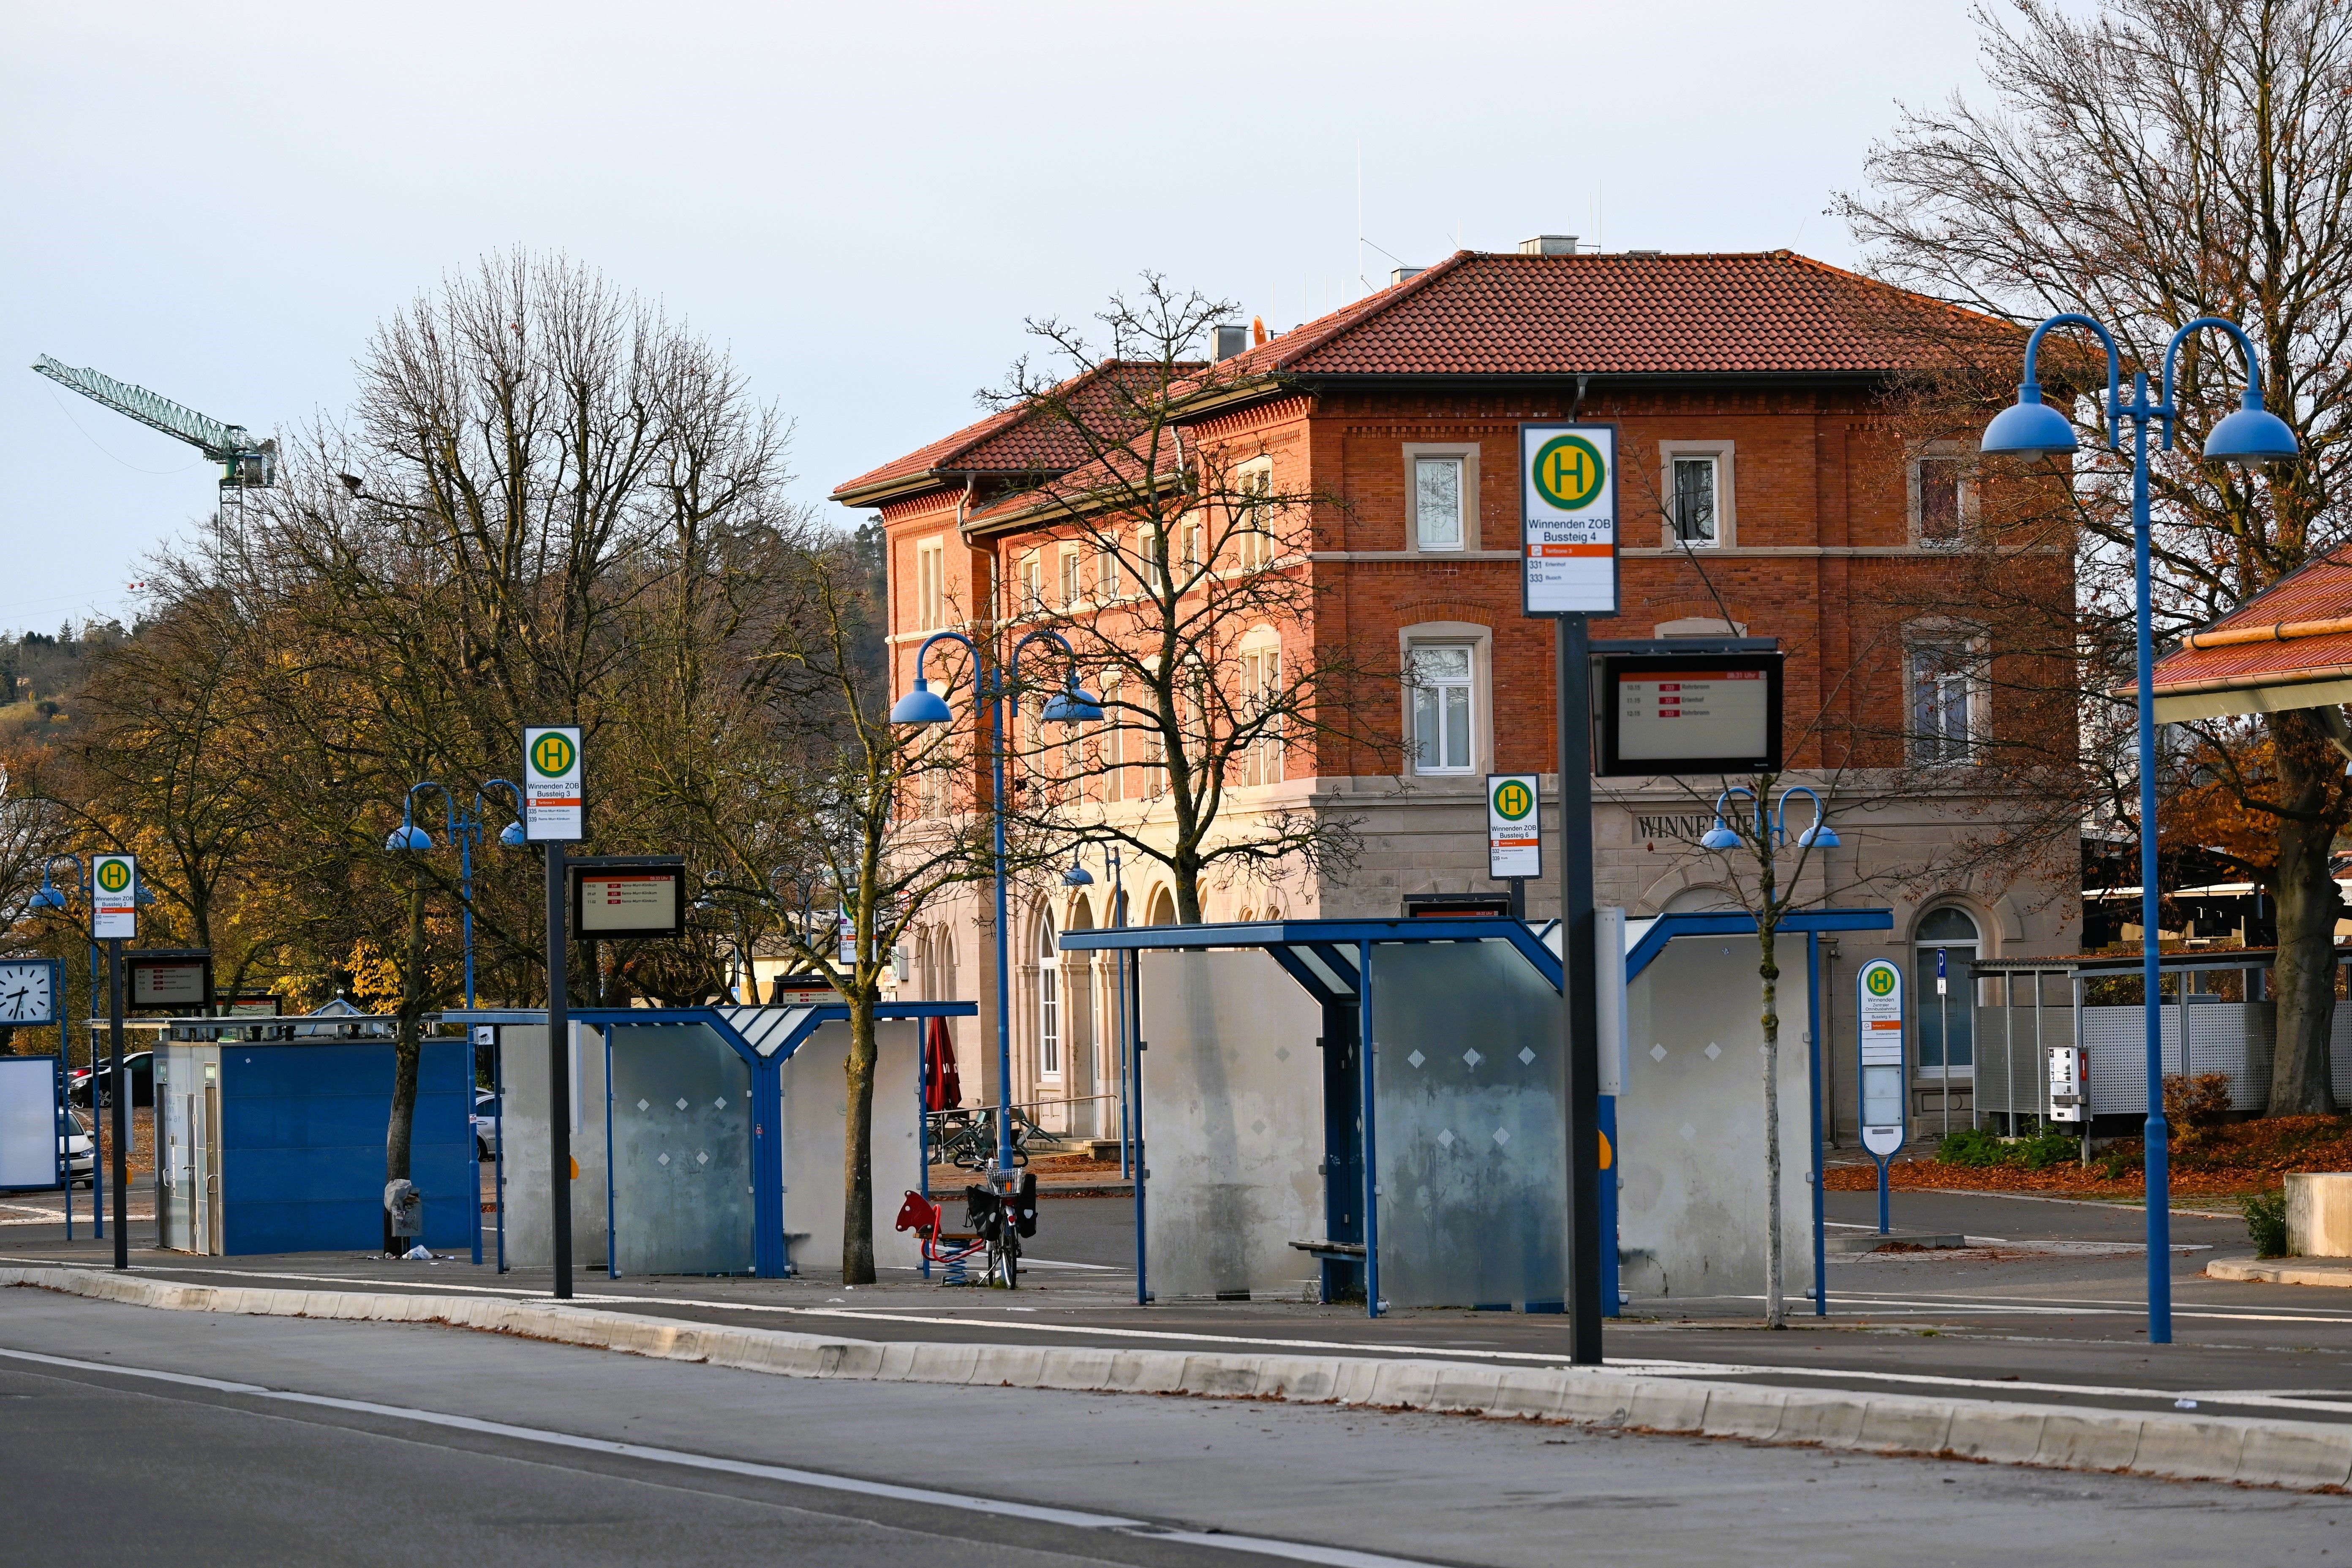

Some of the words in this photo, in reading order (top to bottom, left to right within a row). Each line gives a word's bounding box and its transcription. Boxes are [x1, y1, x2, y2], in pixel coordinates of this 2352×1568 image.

[1554, 452, 1583, 493] H
[1529, 519, 1584, 528] Winnenden
[1588, 519, 1610, 528] ZOB
[1544, 532, 1587, 544] Bussteig
[1590, 532, 1596, 541] 4
[1529, 561, 1541, 569] 331
[1529, 574, 1543, 582] 333
[544, 743, 562, 767] H
[1505, 789, 1521, 811] H
[1639, 815, 1761, 838] WINNEDE
[107, 866, 121, 885] H
[1939, 953, 1943, 974] P
[1874, 974, 1887, 989] H
